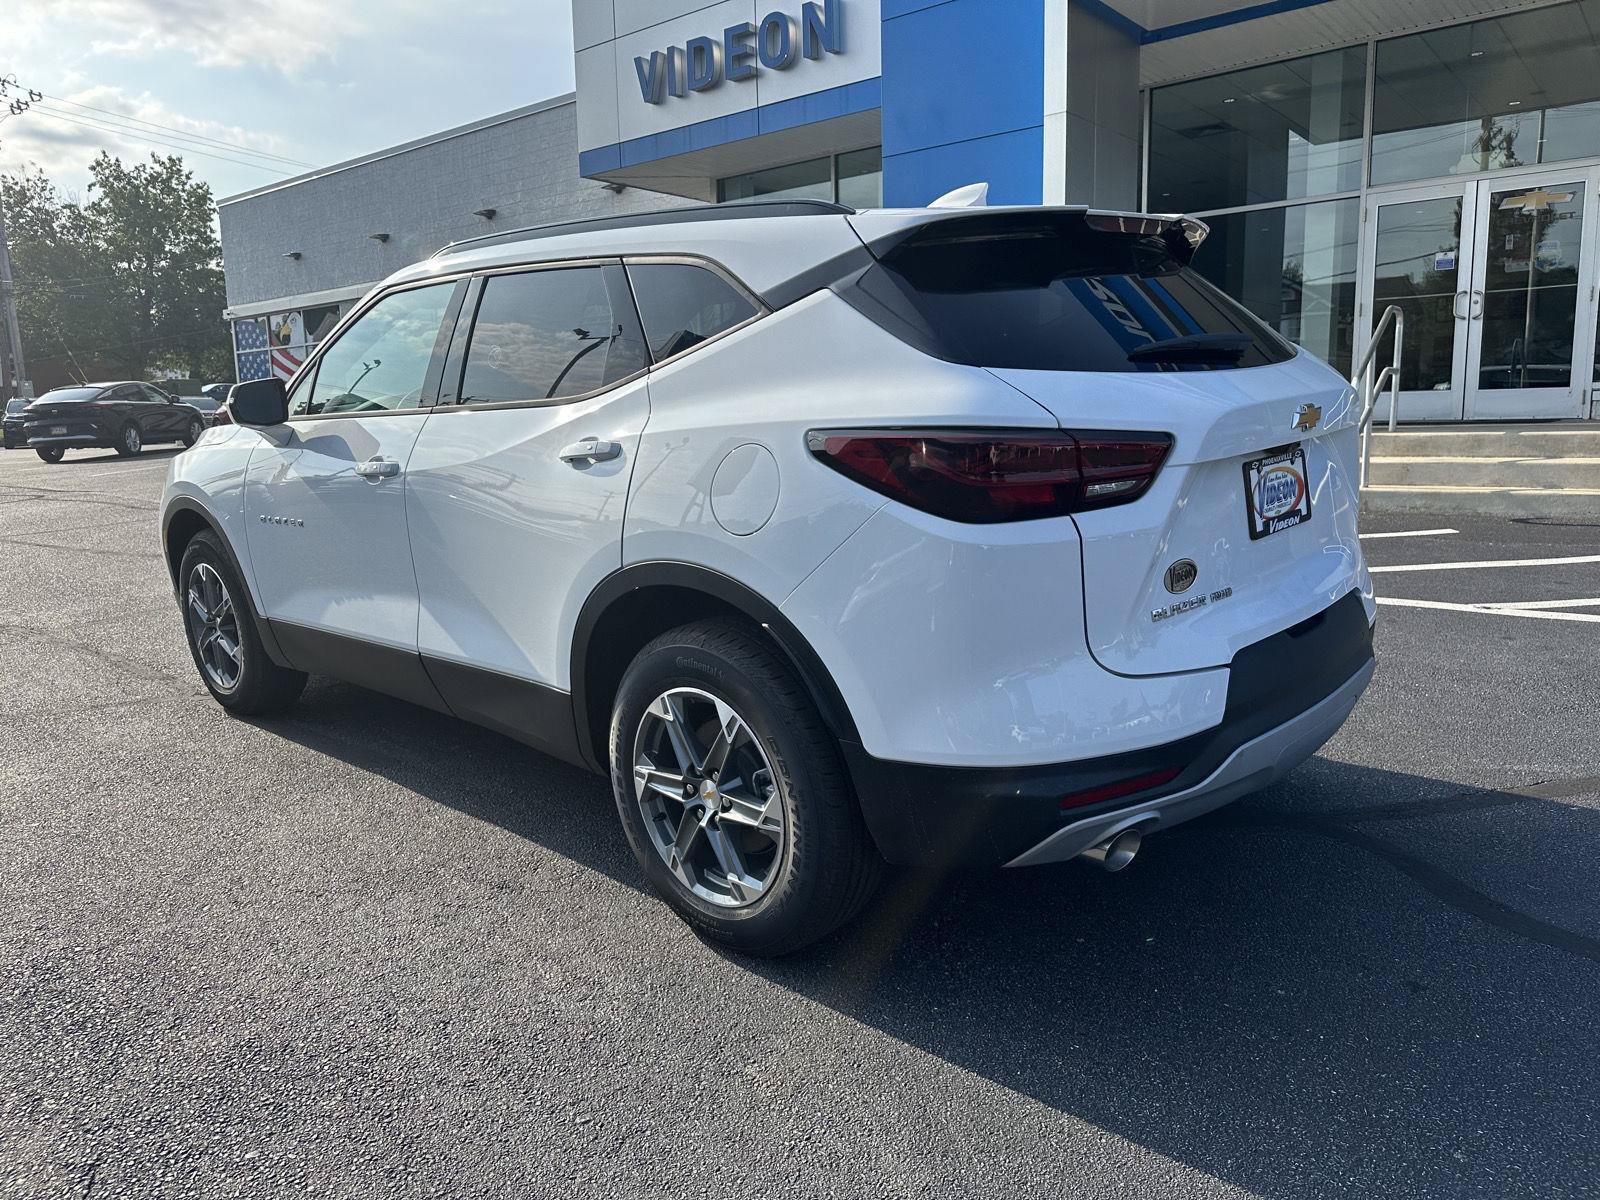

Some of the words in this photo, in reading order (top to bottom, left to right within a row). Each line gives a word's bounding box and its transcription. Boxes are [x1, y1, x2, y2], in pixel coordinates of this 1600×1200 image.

[634, 0, 841, 105] VIDEON
[1257, 469, 1297, 519] VIDEON
[260, 515, 304, 528] BLAZER
[1269, 515, 1301, 534] VIDEON
[1151, 593, 1207, 623] BLAZER
[676, 656, 717, 678] Continental
